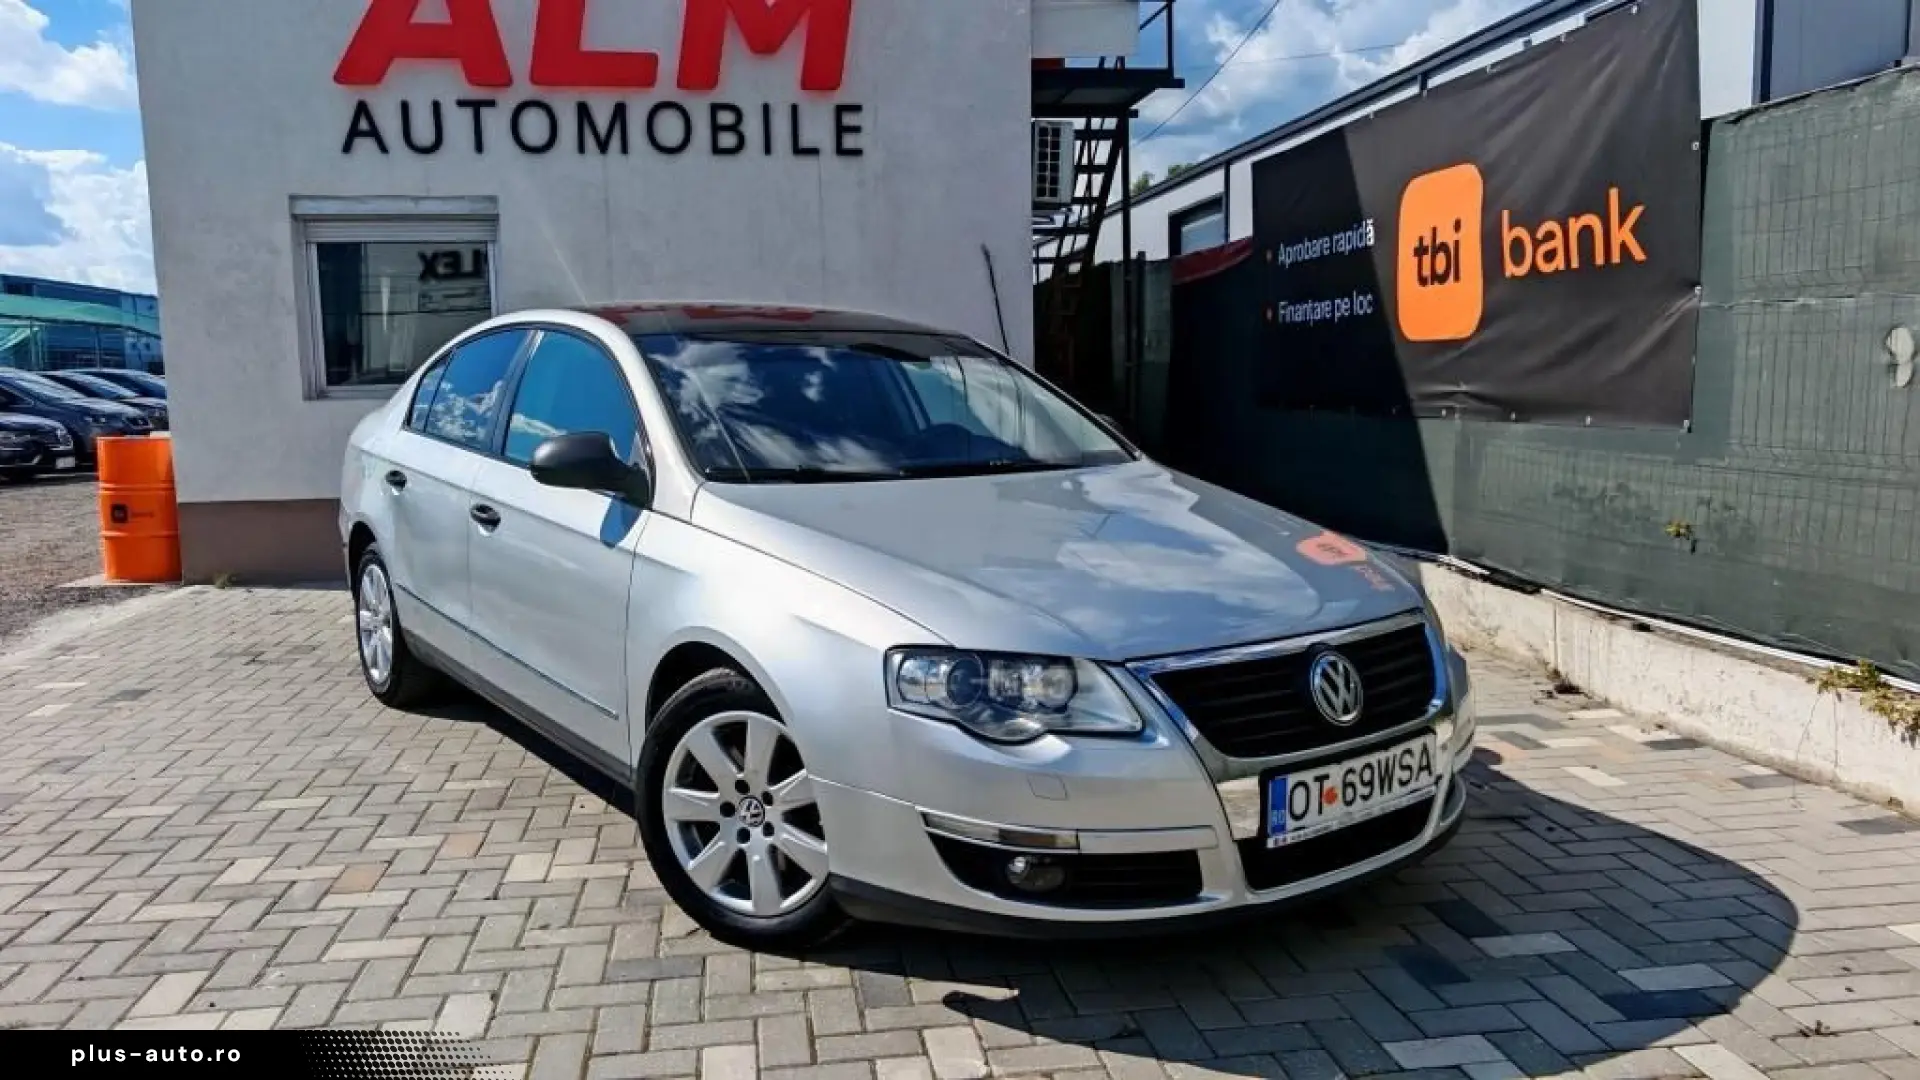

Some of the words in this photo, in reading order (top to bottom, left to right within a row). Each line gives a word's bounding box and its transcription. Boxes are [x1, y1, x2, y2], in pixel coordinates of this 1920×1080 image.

[333, 0, 853, 91] ALM
[341, 99, 864, 157] AUTOMOBILE
[1278, 237, 1331, 269] Aprobare
[1332, 218, 1375, 256] rapidă
[1413, 217, 1462, 287] tbi
[1502, 187, 1647, 278] bank
[1334, 297, 1351, 324] pe
[1353, 290, 1374, 316] loc
[1289, 774, 1331, 822] OT
[1342, 742, 1432, 807] 69WSA
